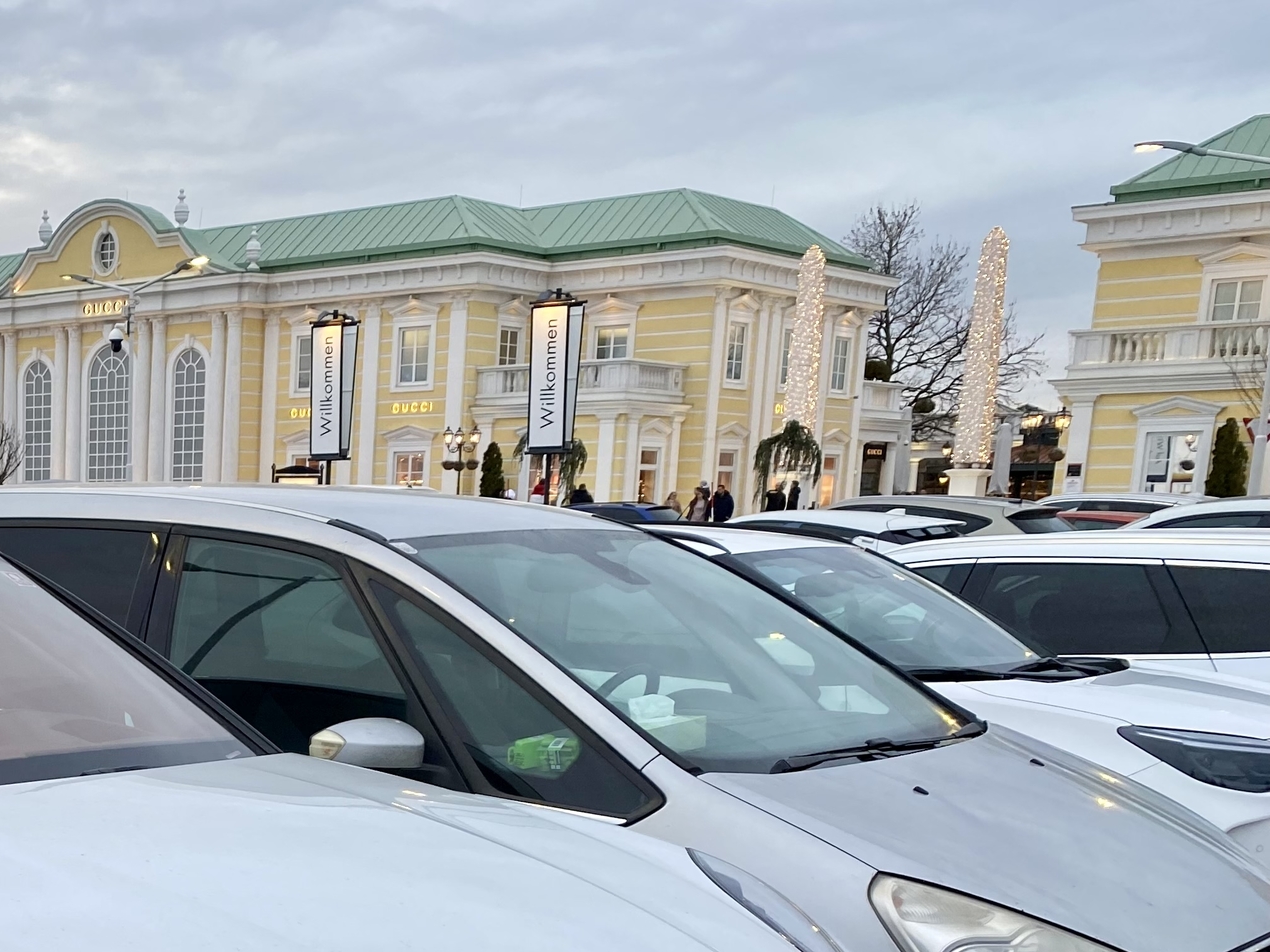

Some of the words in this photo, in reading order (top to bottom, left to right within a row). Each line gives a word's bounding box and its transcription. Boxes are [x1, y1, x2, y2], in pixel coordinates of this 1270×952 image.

[320, 336, 334, 437] Willkommen
[391, 402, 433, 414] GUCCI
[539, 319, 558, 429] Willkommen
